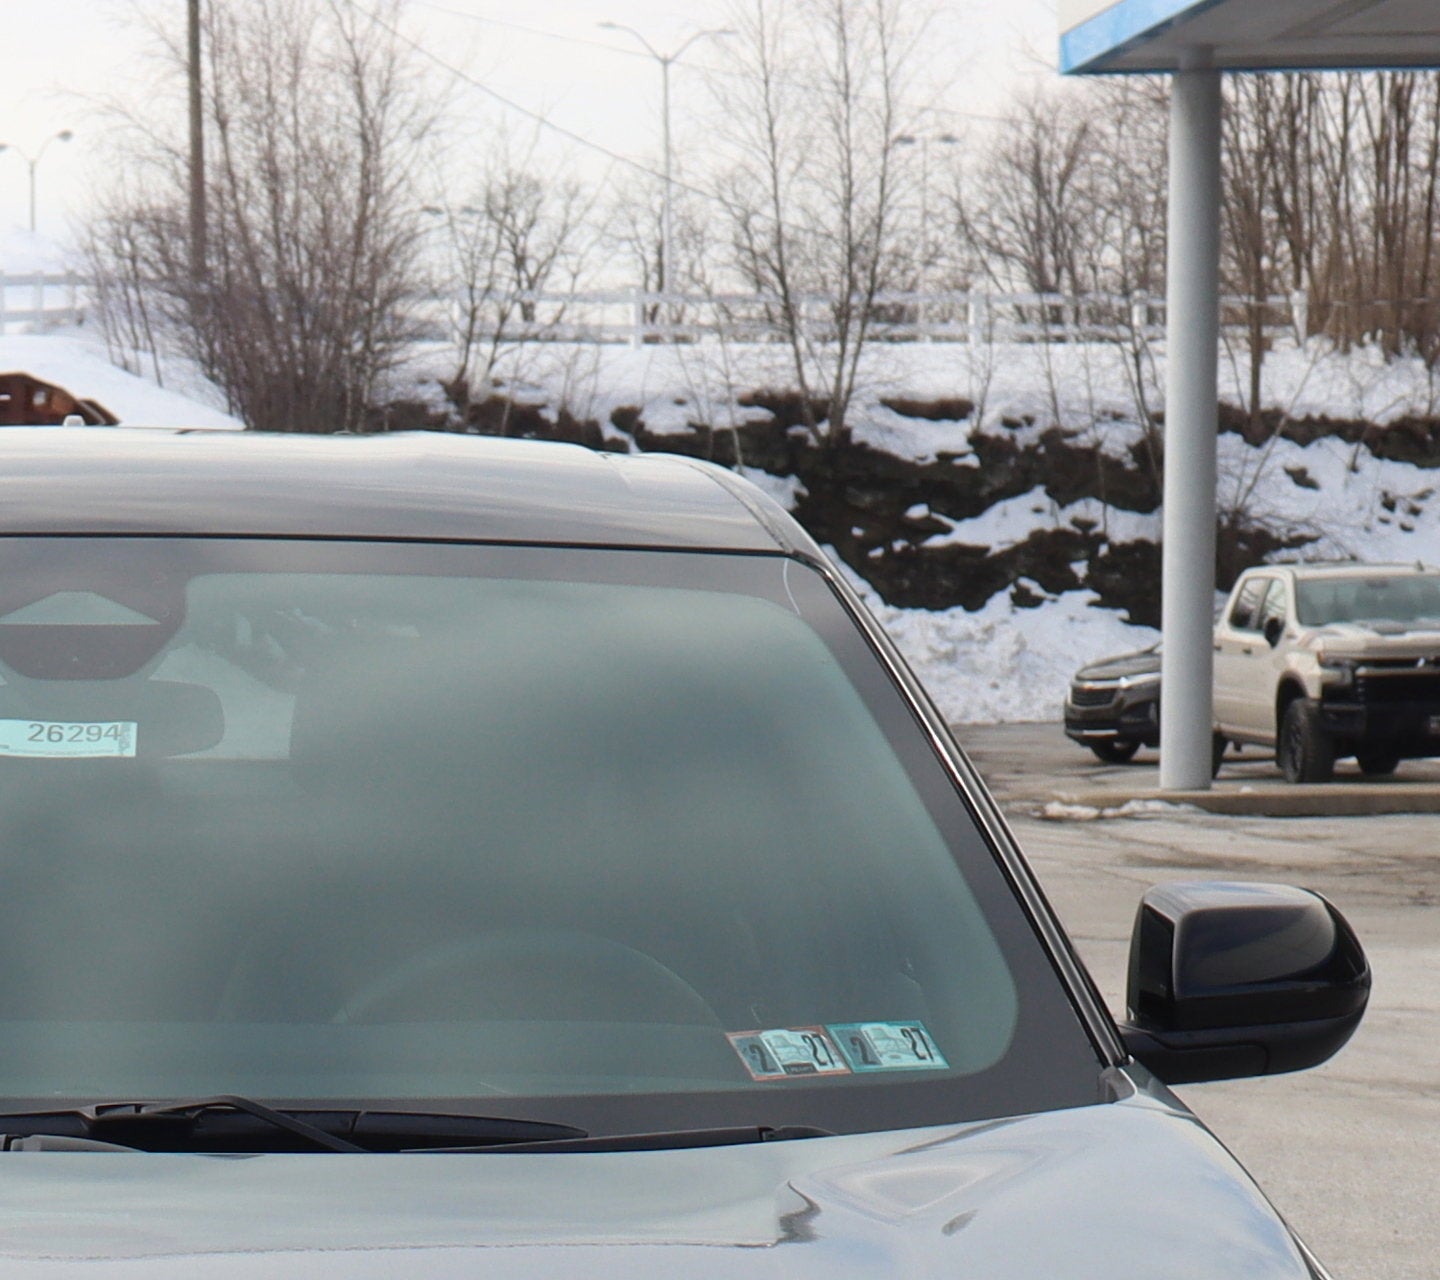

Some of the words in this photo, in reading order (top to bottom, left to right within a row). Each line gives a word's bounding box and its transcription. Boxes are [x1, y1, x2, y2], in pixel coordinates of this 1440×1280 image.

[27, 723, 121, 743] 26294
[800, 1033, 836, 1068] 27
[900, 1027, 935, 1062] 27
